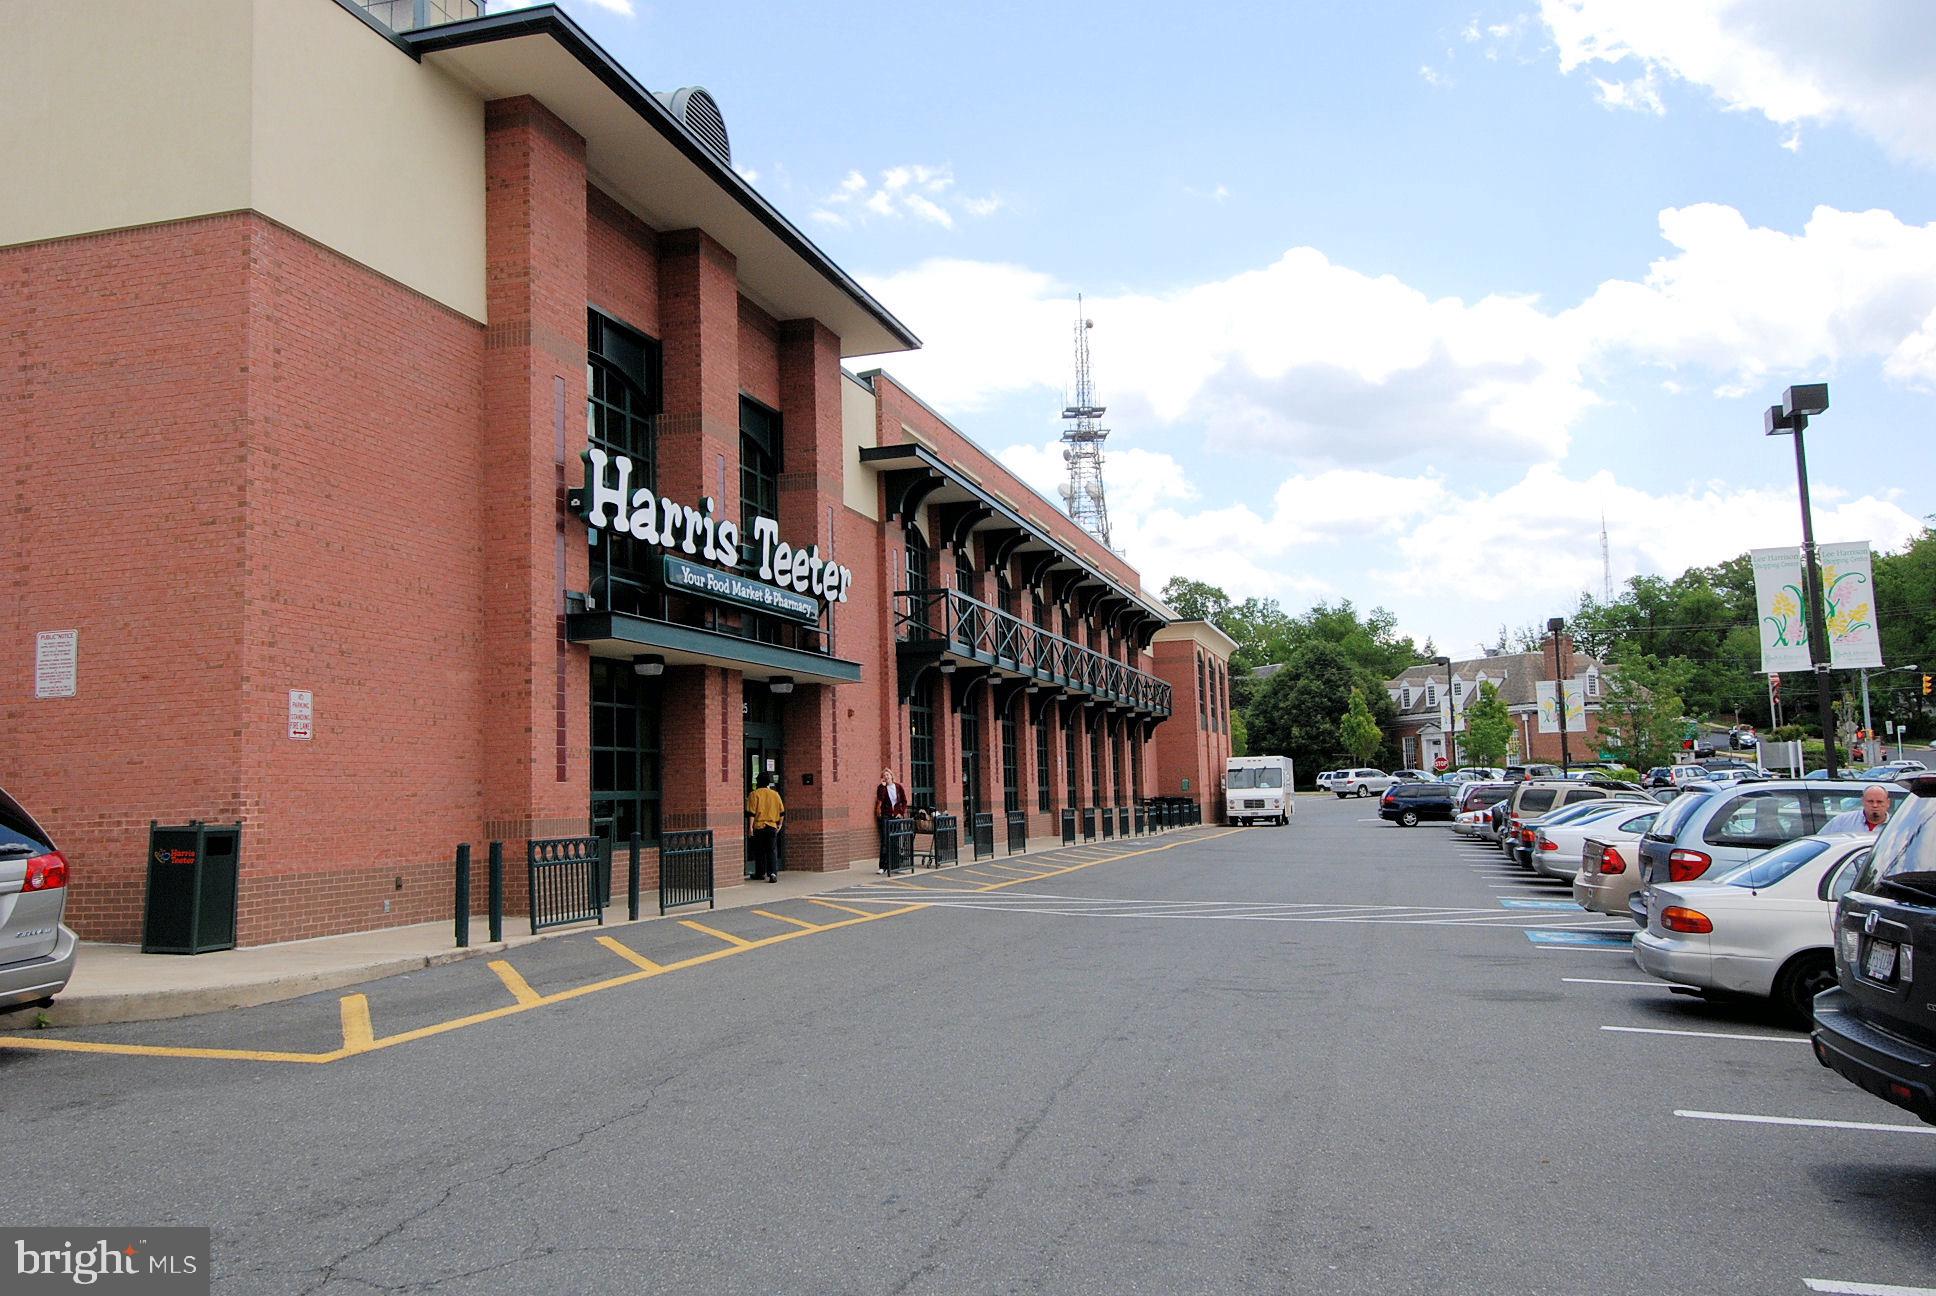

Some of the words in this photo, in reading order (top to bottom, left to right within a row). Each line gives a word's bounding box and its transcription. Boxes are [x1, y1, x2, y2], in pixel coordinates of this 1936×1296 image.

[589, 448, 739, 567] Harris
[754, 516, 852, 603] Teeter
[1768, 553, 1799, 561] Harrison
[1837, 549, 1868, 557] Harrison
[681, 566, 706, 588] Your
[706, 573, 730, 593] Food
[732, 580, 763, 602] Market
[764, 588, 773, 604] &
[773, 591, 812, 617] Pharmacy
[292, 701, 310, 709] PARKING
[291, 713, 311, 721] STANDING
[300, 722, 311, 730] LANE
[171, 848, 196, 857] Harris
